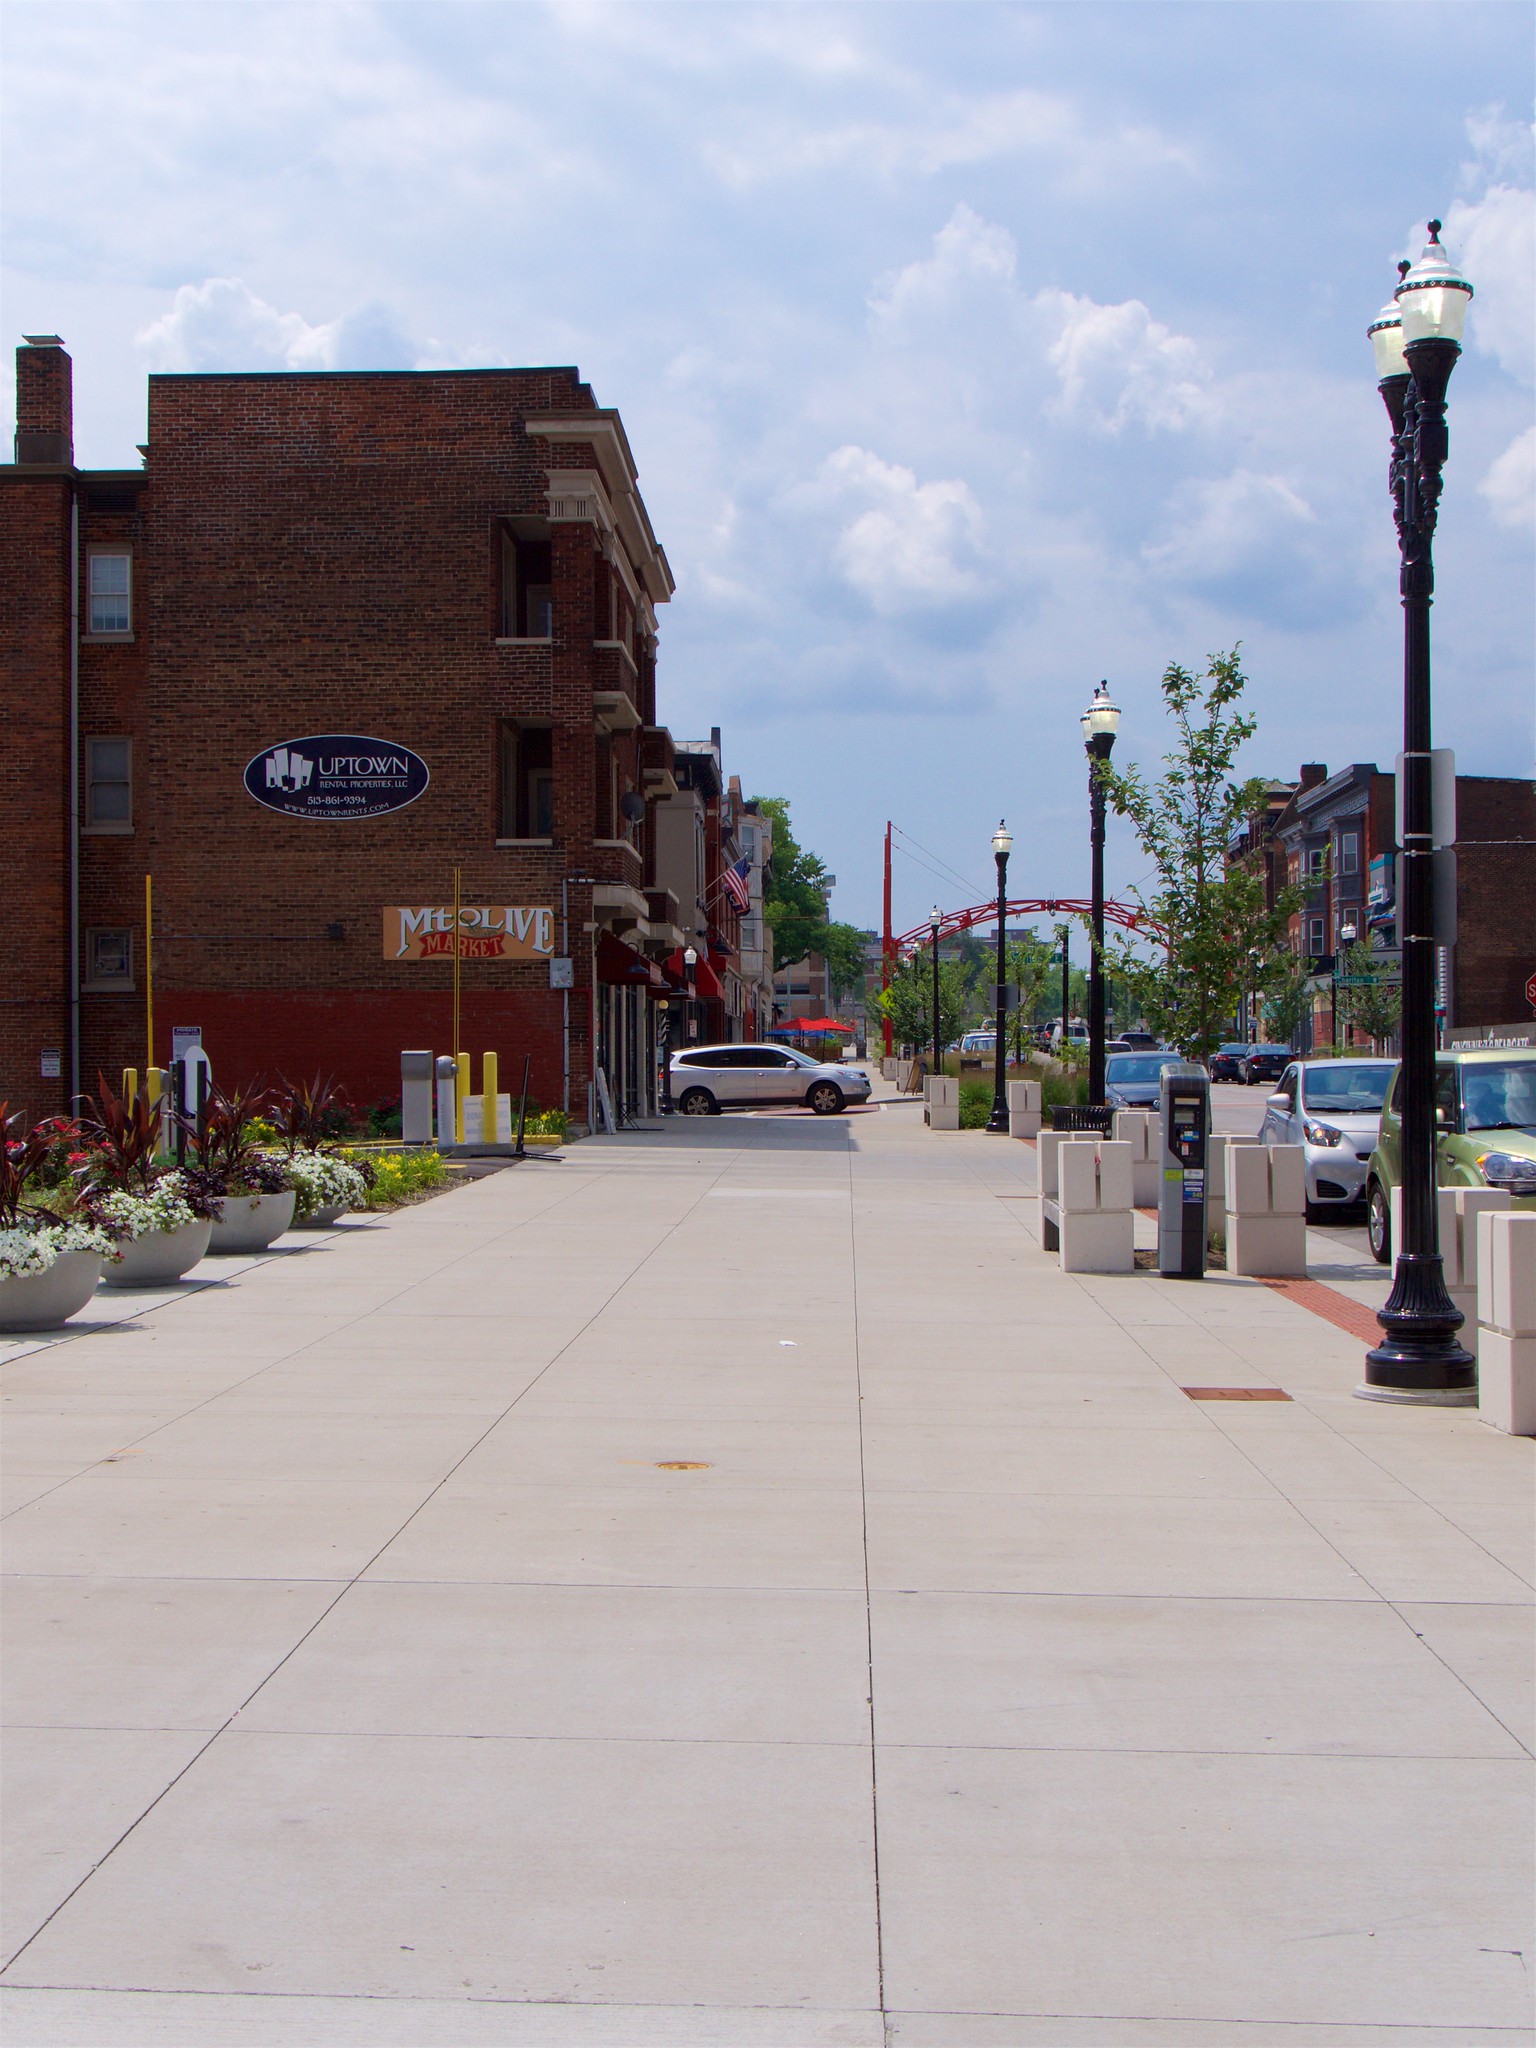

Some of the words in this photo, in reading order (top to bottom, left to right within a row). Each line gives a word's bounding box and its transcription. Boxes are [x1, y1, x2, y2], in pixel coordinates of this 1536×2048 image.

[319, 756, 408, 775] UPTOWN
[320, 780, 348, 789] RENTAL
[395, 780, 408, 788] LLC
[307, 796, 366, 805] 513-861-9394
[283, 802, 390, 816] WWW.UPTOWNRENTS.COM
[459, 907, 555, 954] OLIVE
[426, 934, 501, 958] MARKET
